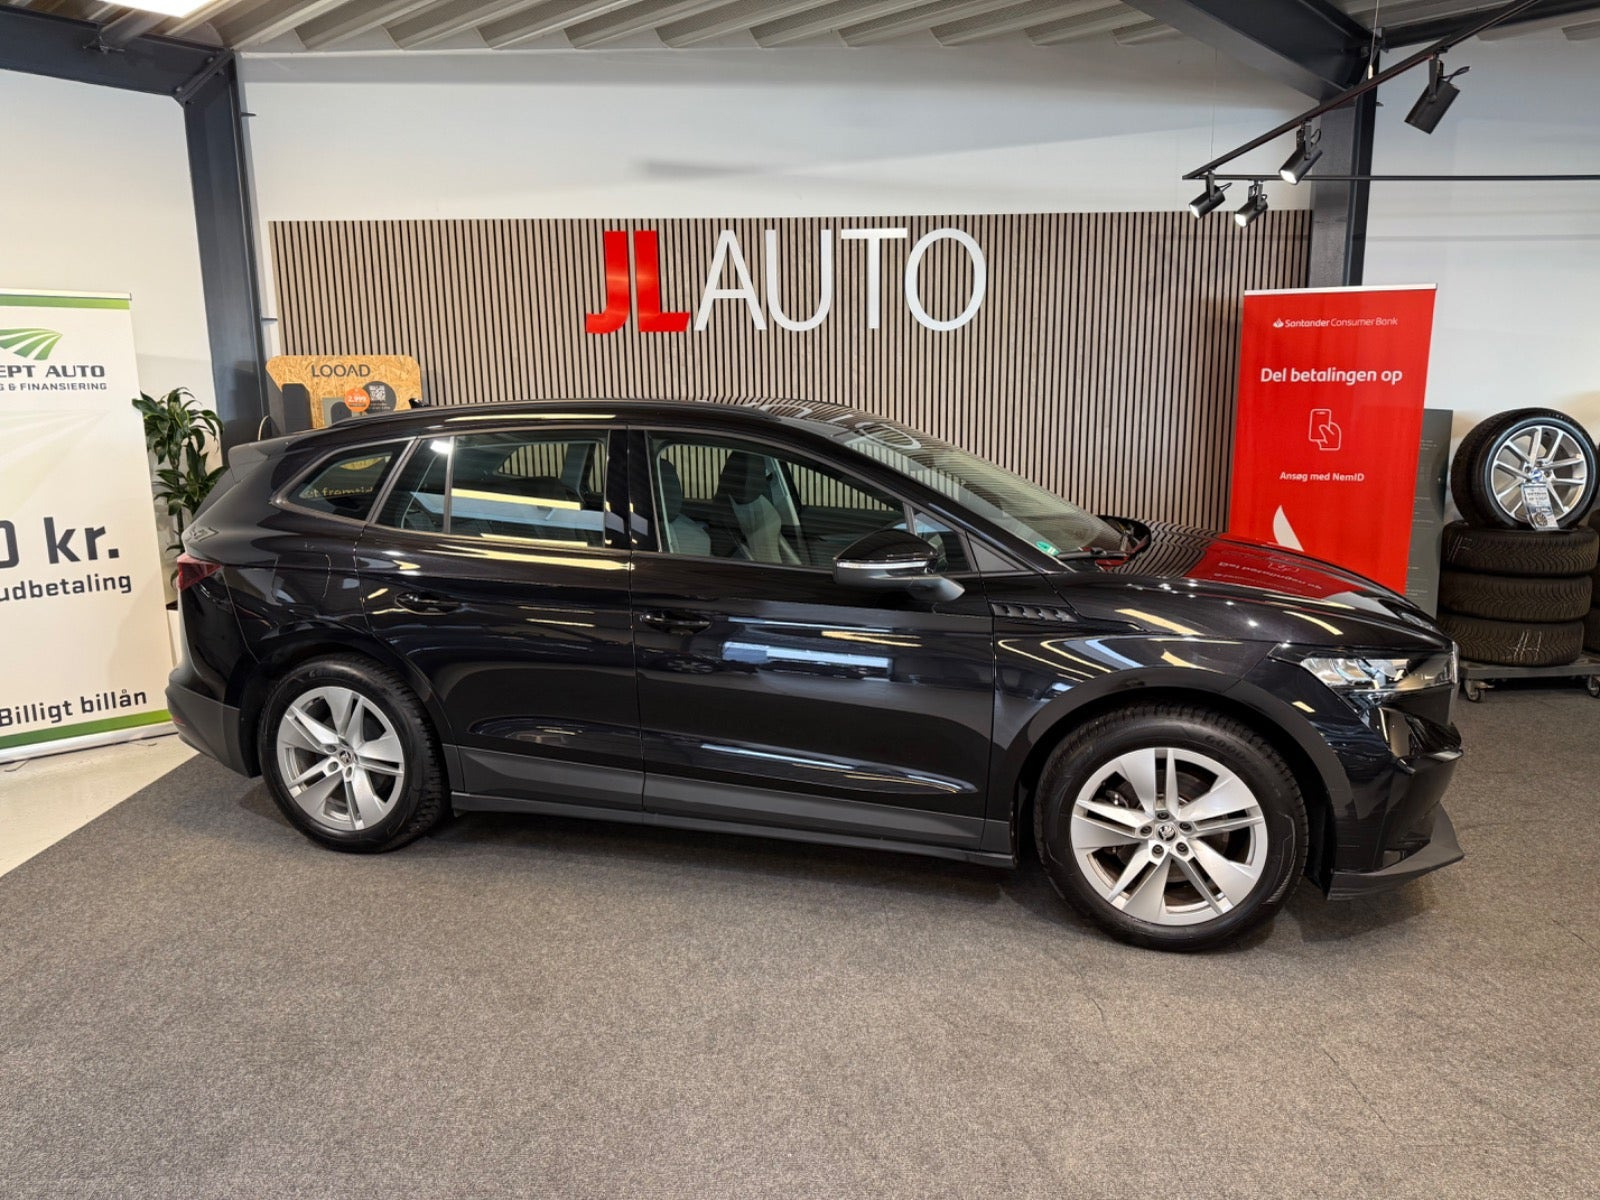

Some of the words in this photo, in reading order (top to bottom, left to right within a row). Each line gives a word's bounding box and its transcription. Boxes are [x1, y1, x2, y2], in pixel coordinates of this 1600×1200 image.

[586, 230, 690, 334] JL
[694, 228, 987, 332] AUTO
[1285, 319, 1330, 328] Santander
[1330, 318, 1374, 327] Consumer
[1375, 317, 1398, 326] Bank
[0, 365, 36, 378] EPT
[45, 365, 105, 378] AUTO
[311, 364, 371, 377] LOOAD
[1260, 367, 1287, 382] Del
[1290, 367, 1377, 386] betalingen
[1381, 370, 1403, 385] op
[20, 382, 107, 391] FINANSIERING
[1280, 471, 1308, 483] Ansøg
[1310, 472, 1331, 481] med
[1332, 472, 1365, 482] NemID
[43, 516, 120, 565] kr.
[0, 700, 73, 727] Billigt
[80, 688, 148, 714] billån
